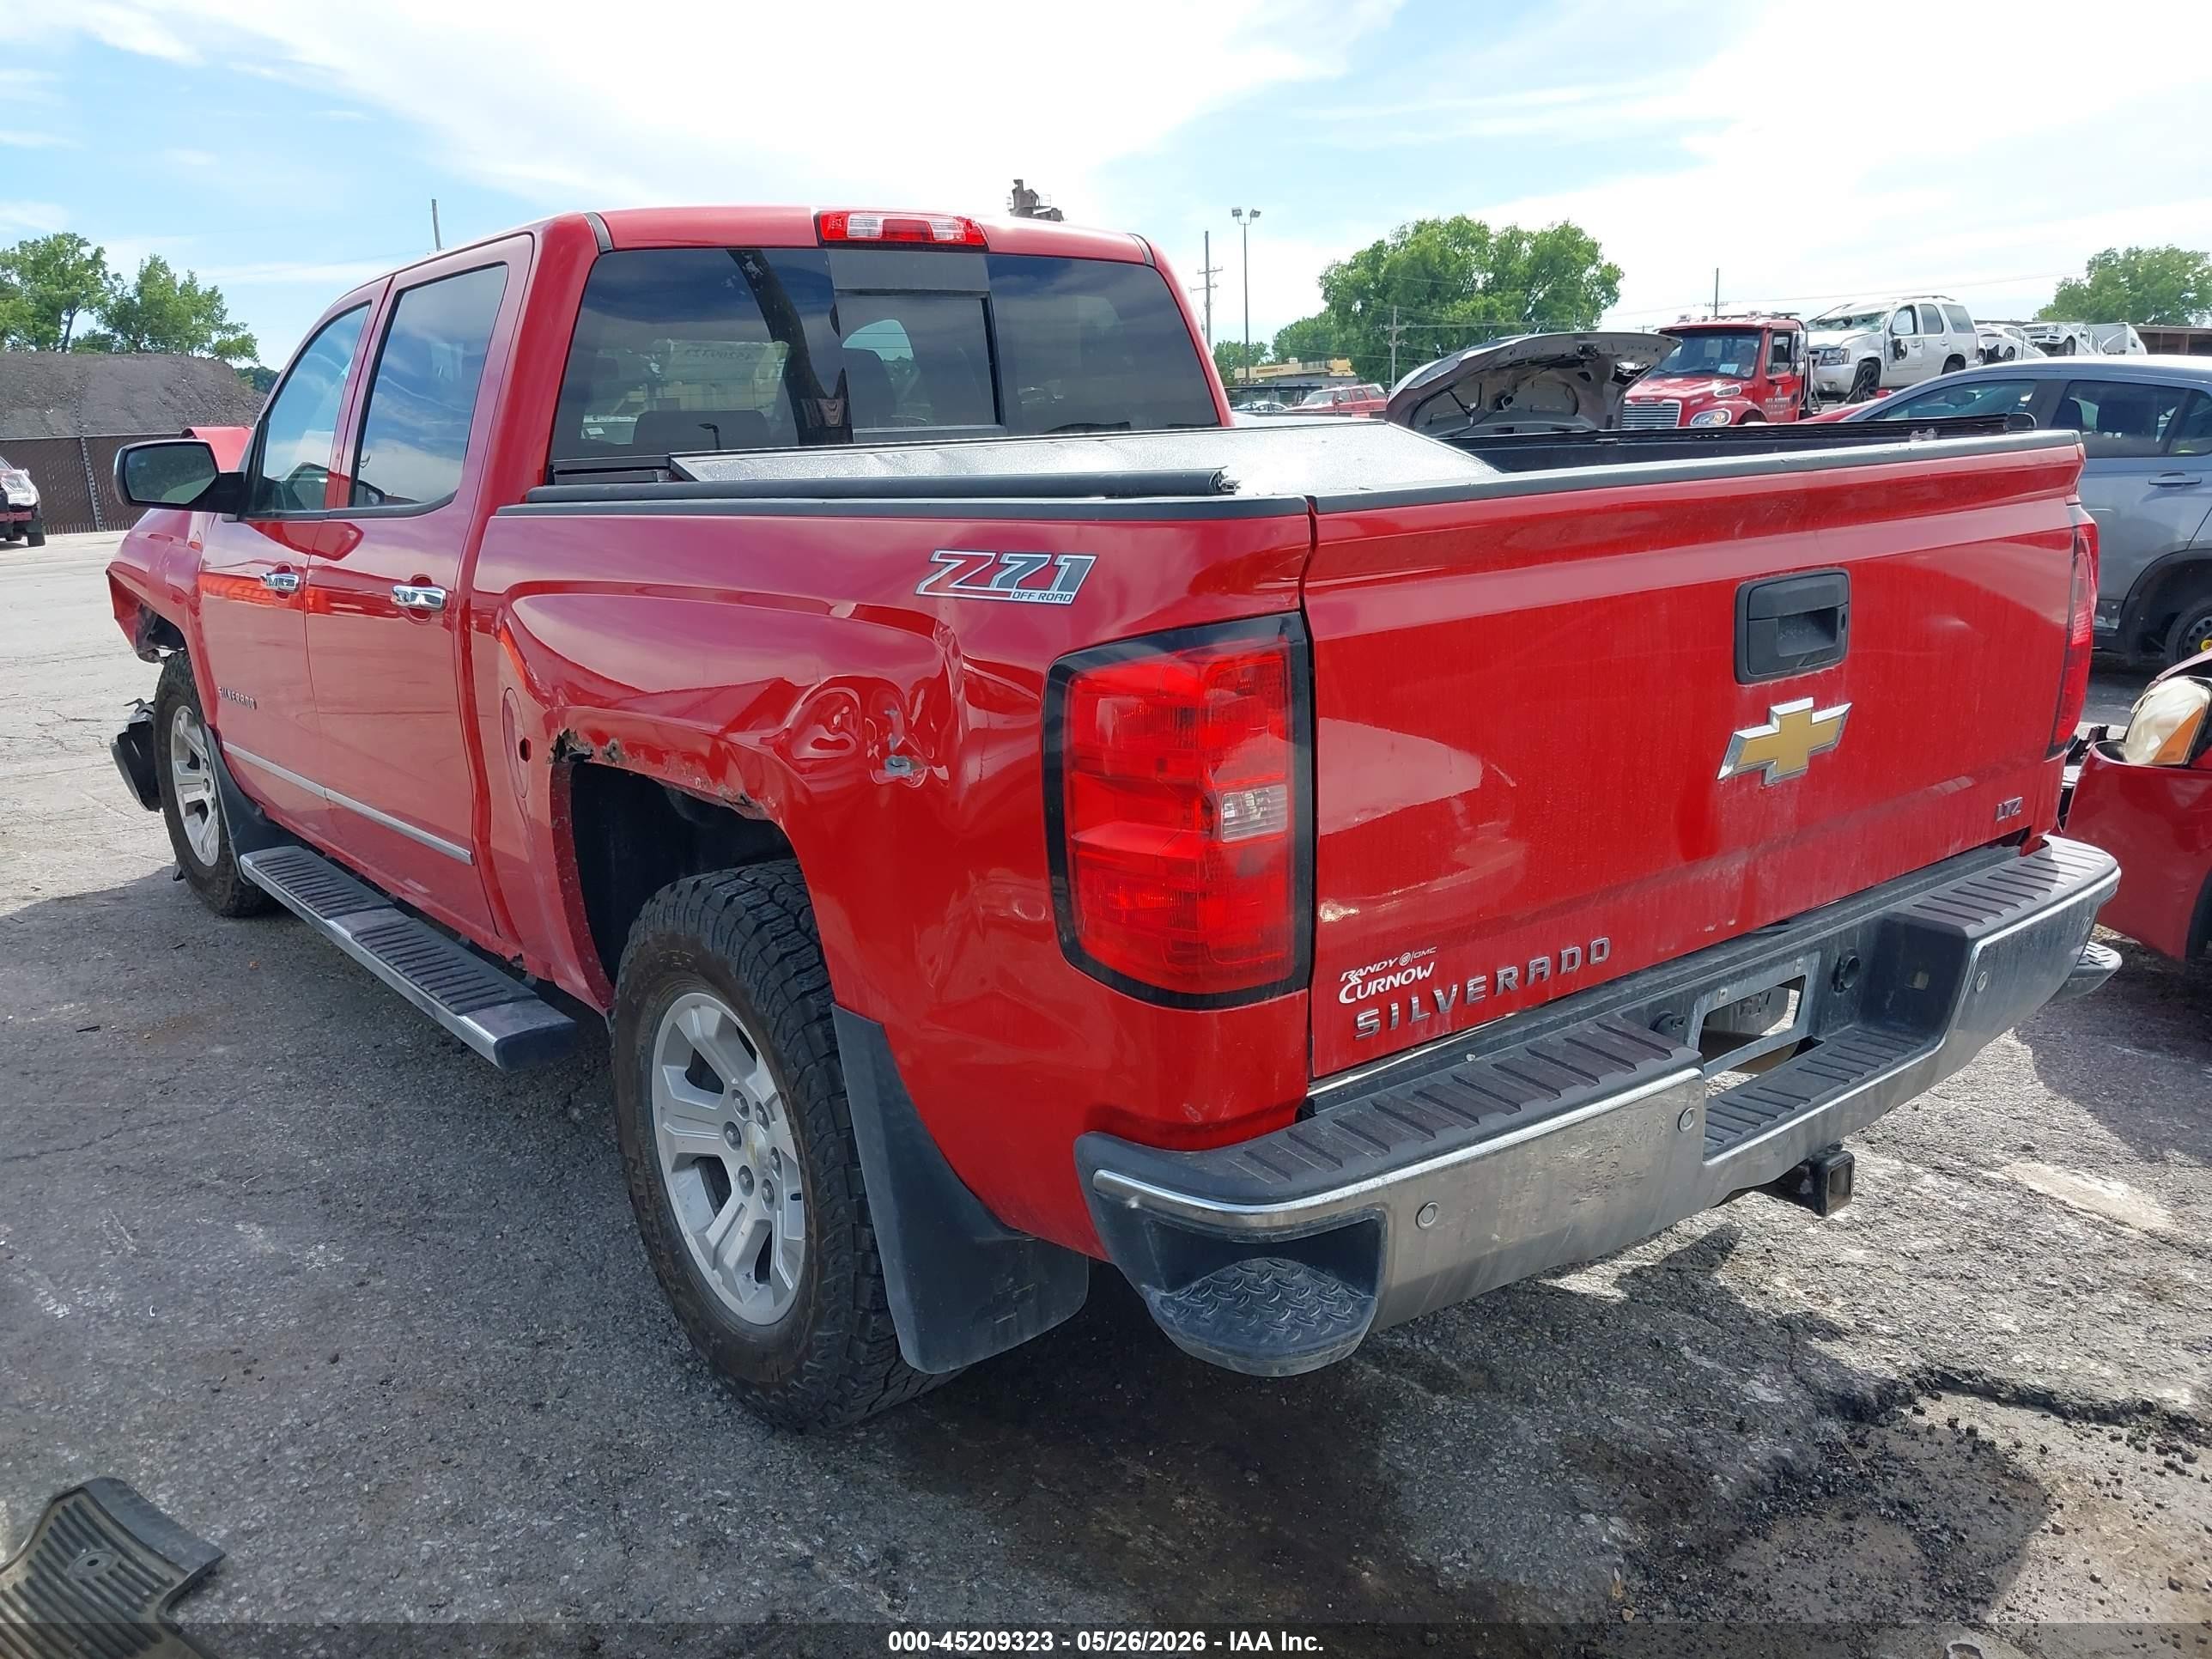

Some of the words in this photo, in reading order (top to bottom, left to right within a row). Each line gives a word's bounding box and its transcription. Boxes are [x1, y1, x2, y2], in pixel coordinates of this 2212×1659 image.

[915, 550, 1098, 603] Z71
[1012, 591, 1036, 600] OFF
[1037, 592, 1073, 603] ROAD
[216, 686, 258, 710] SILVERADO
[1996, 796, 2023, 822] LTZ
[1339, 962, 1435, 1004] CURNOW
[1340, 957, 1399, 983] RANDY
[1413, 946, 1437, 959] GMC
[1354, 937, 1611, 1041] SILVERADO
